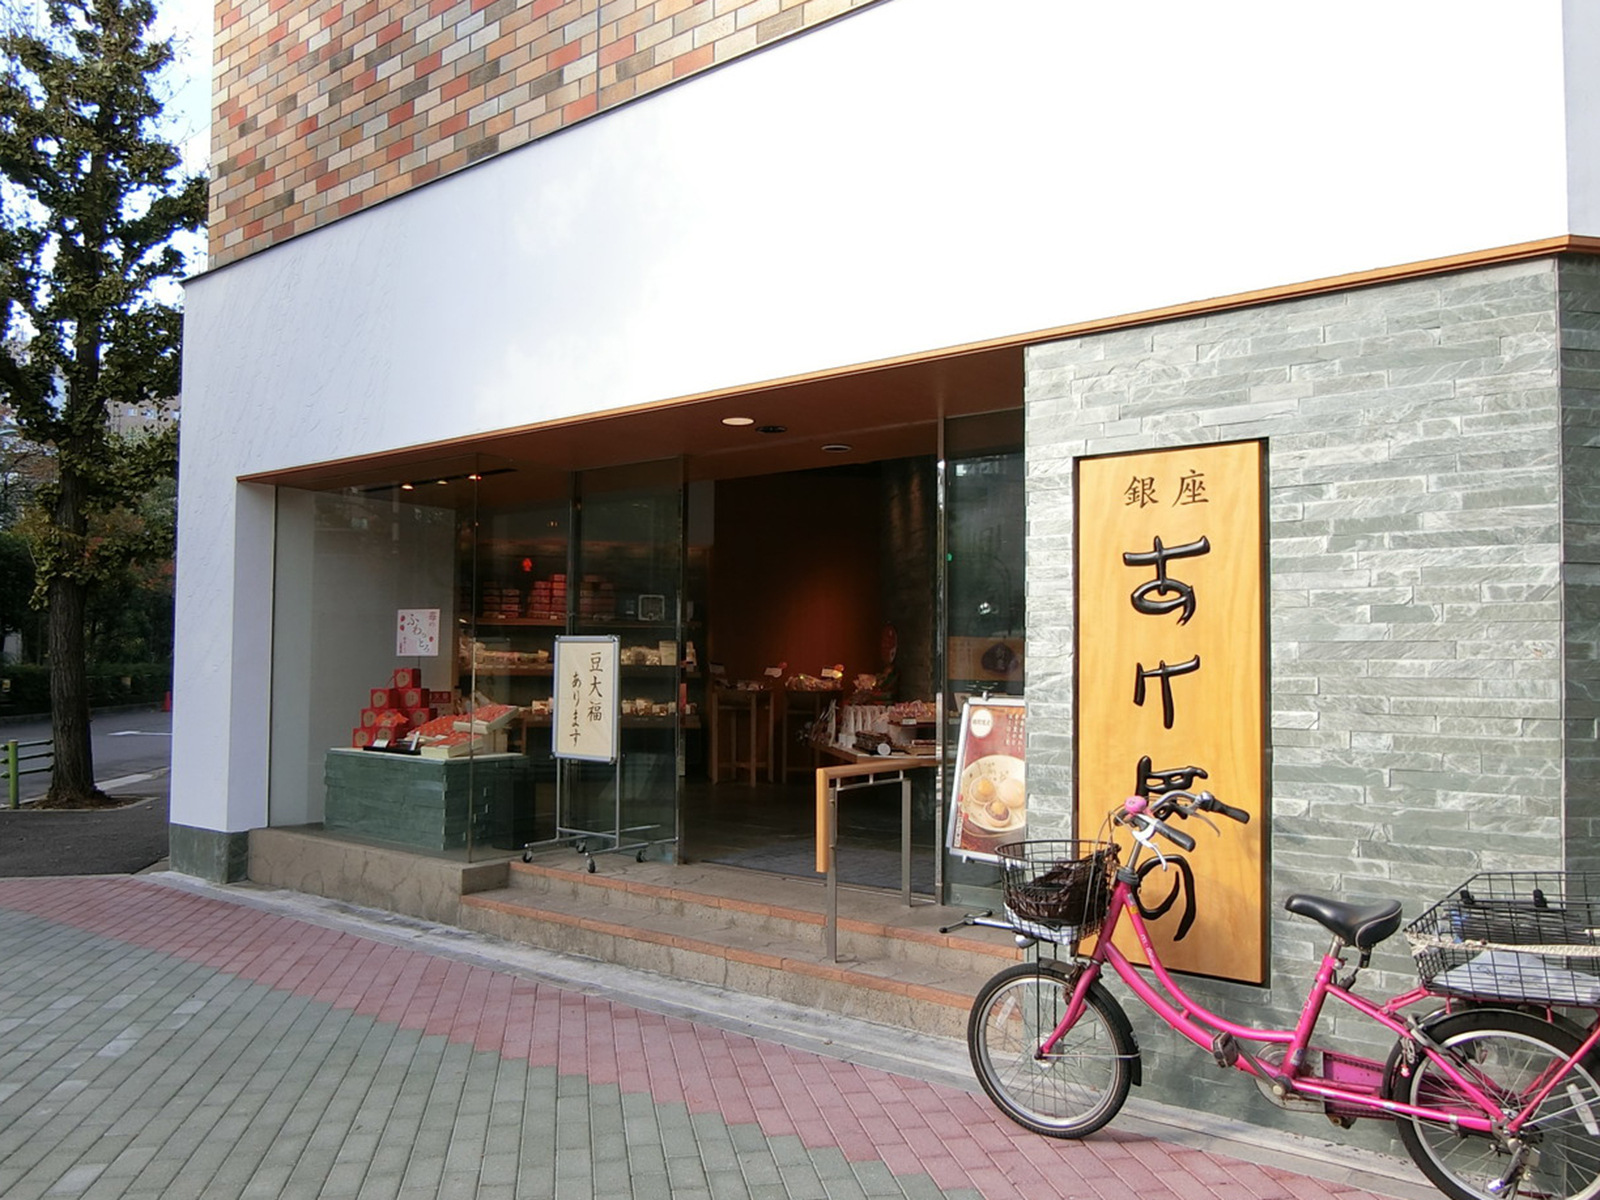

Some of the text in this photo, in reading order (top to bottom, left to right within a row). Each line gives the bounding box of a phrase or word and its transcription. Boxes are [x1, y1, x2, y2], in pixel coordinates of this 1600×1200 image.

[1123, 468, 1210, 509] 銀座
[569, 671, 582, 747] あります
[587, 651, 603, 722] 豆大福
